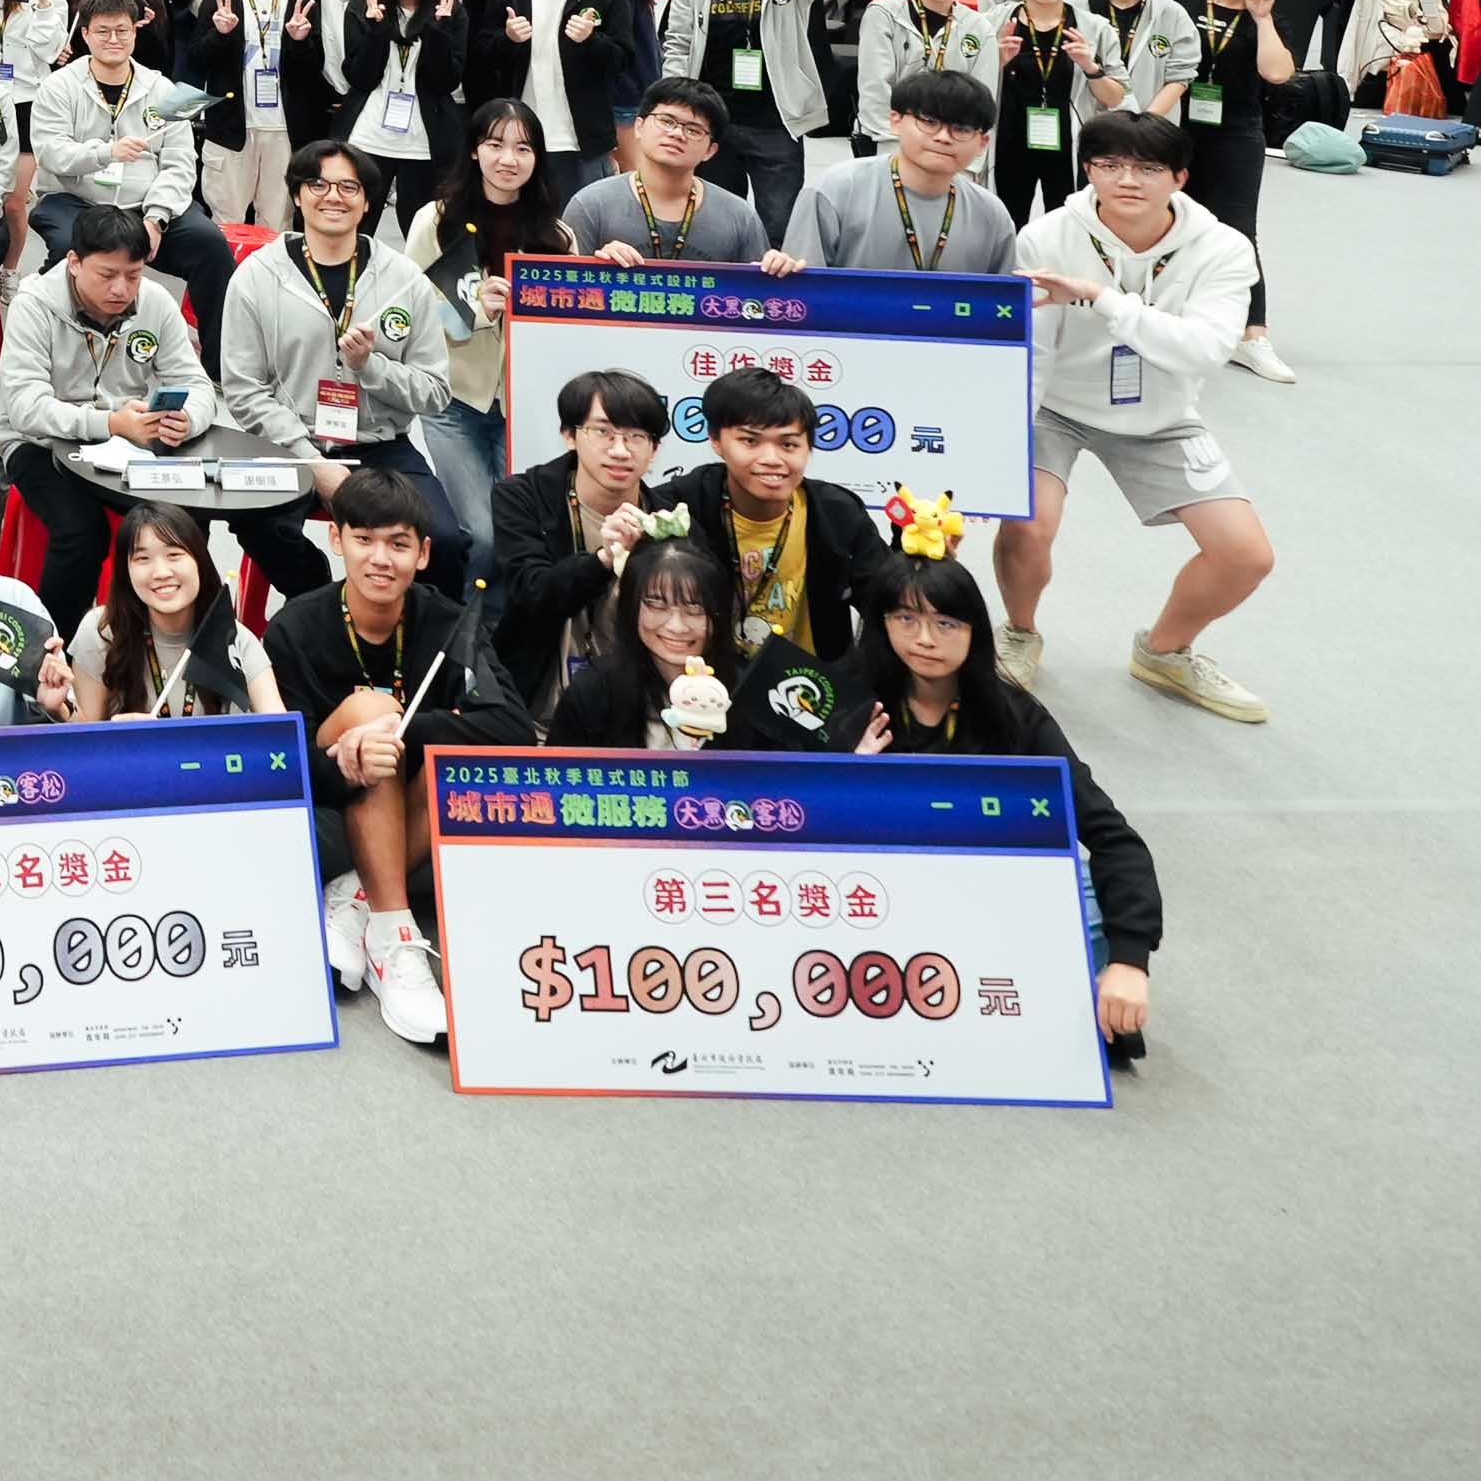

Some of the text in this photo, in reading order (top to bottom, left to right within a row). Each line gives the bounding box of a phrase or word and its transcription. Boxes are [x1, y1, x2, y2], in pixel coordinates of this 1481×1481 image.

[519, 268, 717, 289] 2025臺北秋季程式設計節
[910, 425, 945, 454] 元
[444, 766, 691, 789] 2025臺北秋季程式設計節
[653, 877, 879, 919] 第三名獎金
[220, 928, 260, 969] 元
[518, 935, 1021, 1031] $100,000 元
